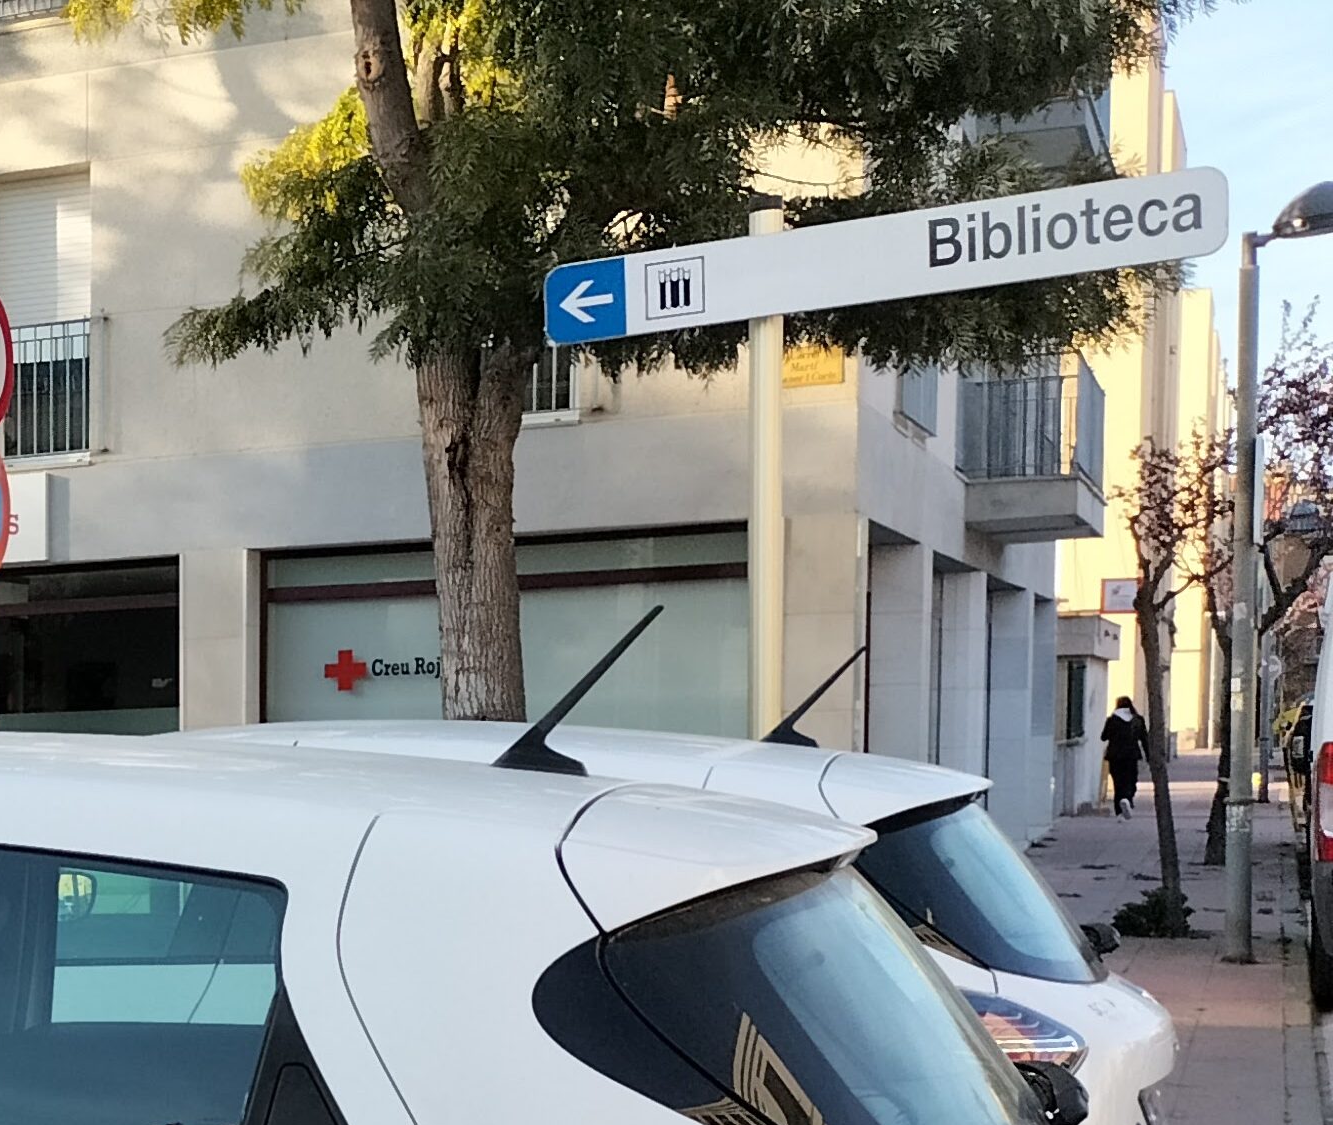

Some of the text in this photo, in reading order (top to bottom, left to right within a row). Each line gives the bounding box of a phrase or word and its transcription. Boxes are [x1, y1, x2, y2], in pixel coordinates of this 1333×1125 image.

[927, 190, 1204, 268] Biblioteca
[371, 656, 442, 679] Creu Roj
